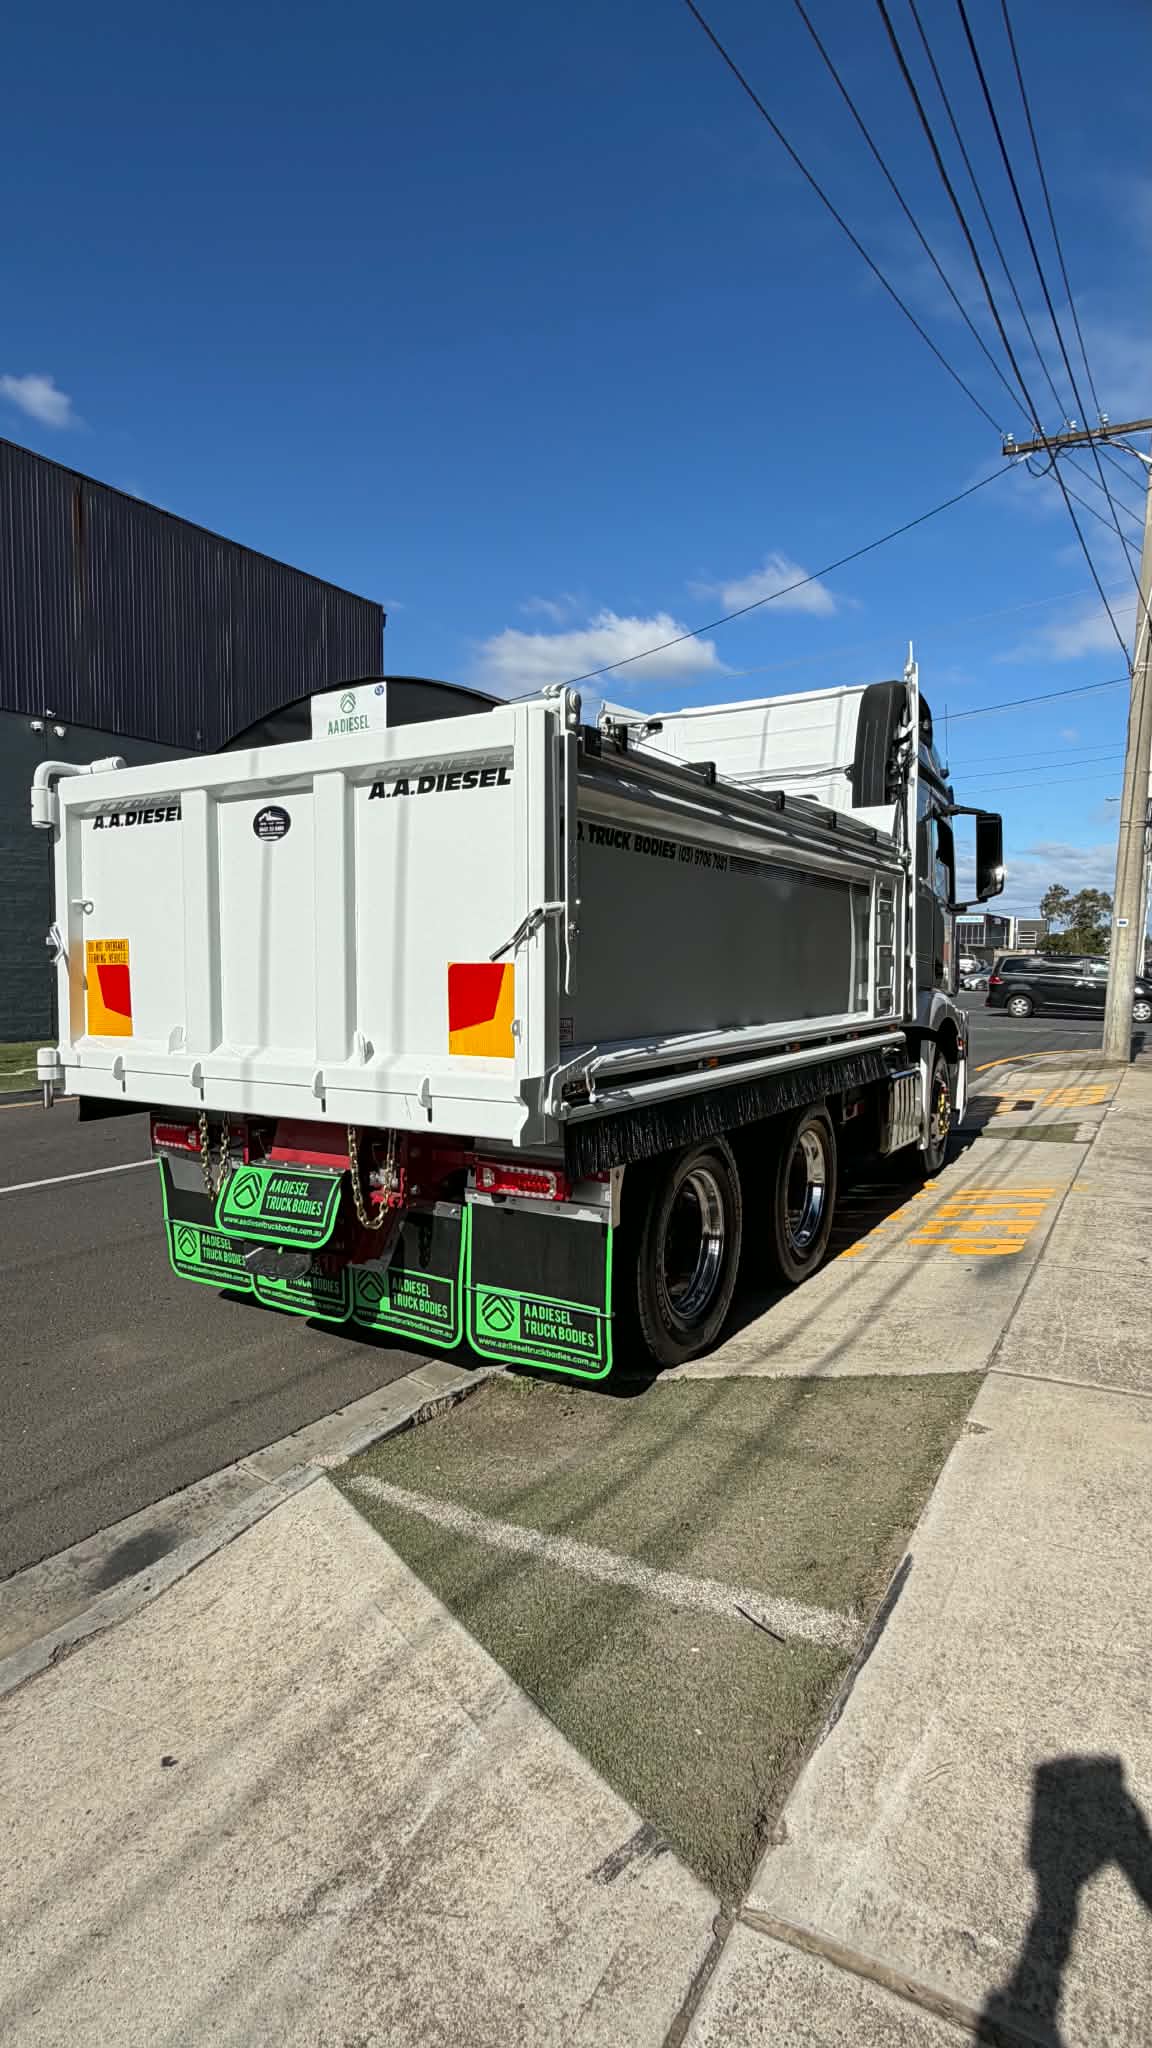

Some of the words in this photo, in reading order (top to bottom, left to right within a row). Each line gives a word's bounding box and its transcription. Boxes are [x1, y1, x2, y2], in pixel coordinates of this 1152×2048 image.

[368, 767, 511, 800] A.A.DIESEL
[588, 823, 632, 850] TRUCK
[633, 834, 677, 859] BODIES
[265, 1196, 293, 1213] TRUCK
[292, 1199, 323, 1216] BODIES
[203, 1247, 224, 1261] TRUCK
[224, 1250, 246, 1266] BODIES
[392, 1292, 419, 1311] TRUCK
[420, 1298, 448, 1318] BODIES
[524, 1319, 559, 1338] TRUCK
[559, 1326, 594, 1347] BODIES
[479, 1337, 600, 1369] www.aadieseltruckbodies.com.au
